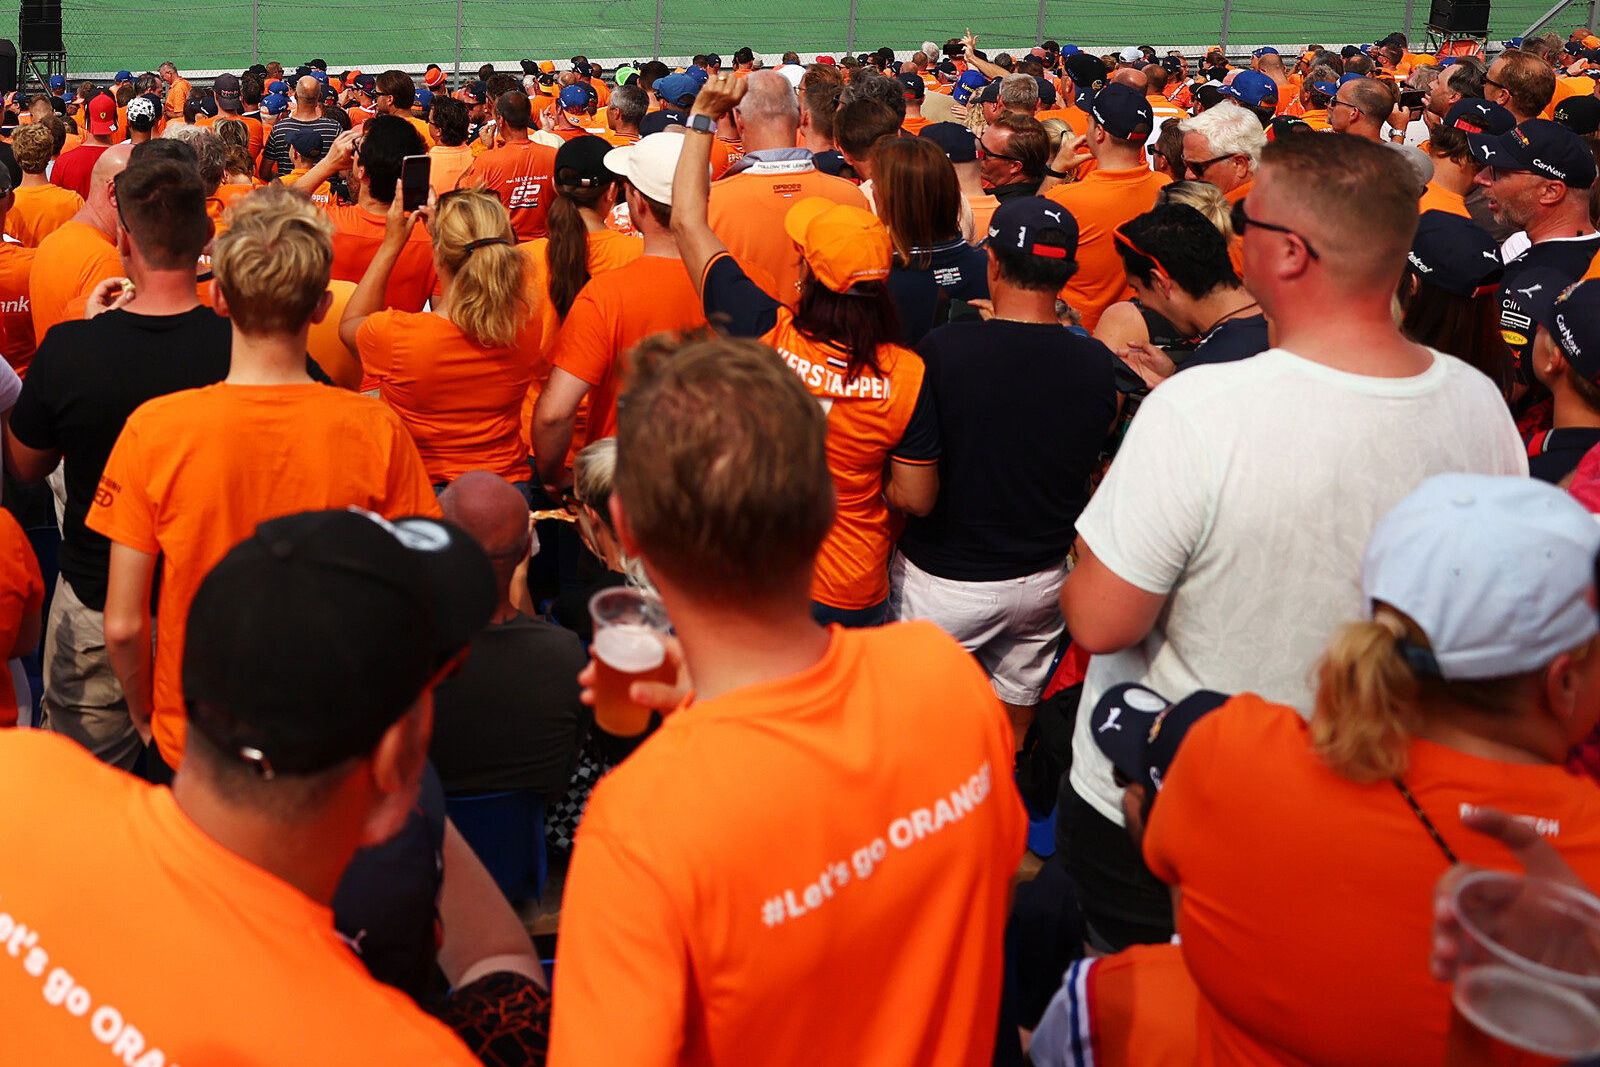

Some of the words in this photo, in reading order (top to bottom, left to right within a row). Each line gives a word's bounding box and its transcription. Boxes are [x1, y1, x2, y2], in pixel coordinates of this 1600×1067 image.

[1532, 158, 1567, 180] CarNext
[1556, 314, 1582, 357] CarNext
[761, 859, 850, 928] #Let's
[852, 837, 887, 880] go
[42, 965, 92, 1018] go
[90, 1003, 181, 1067] ORA
